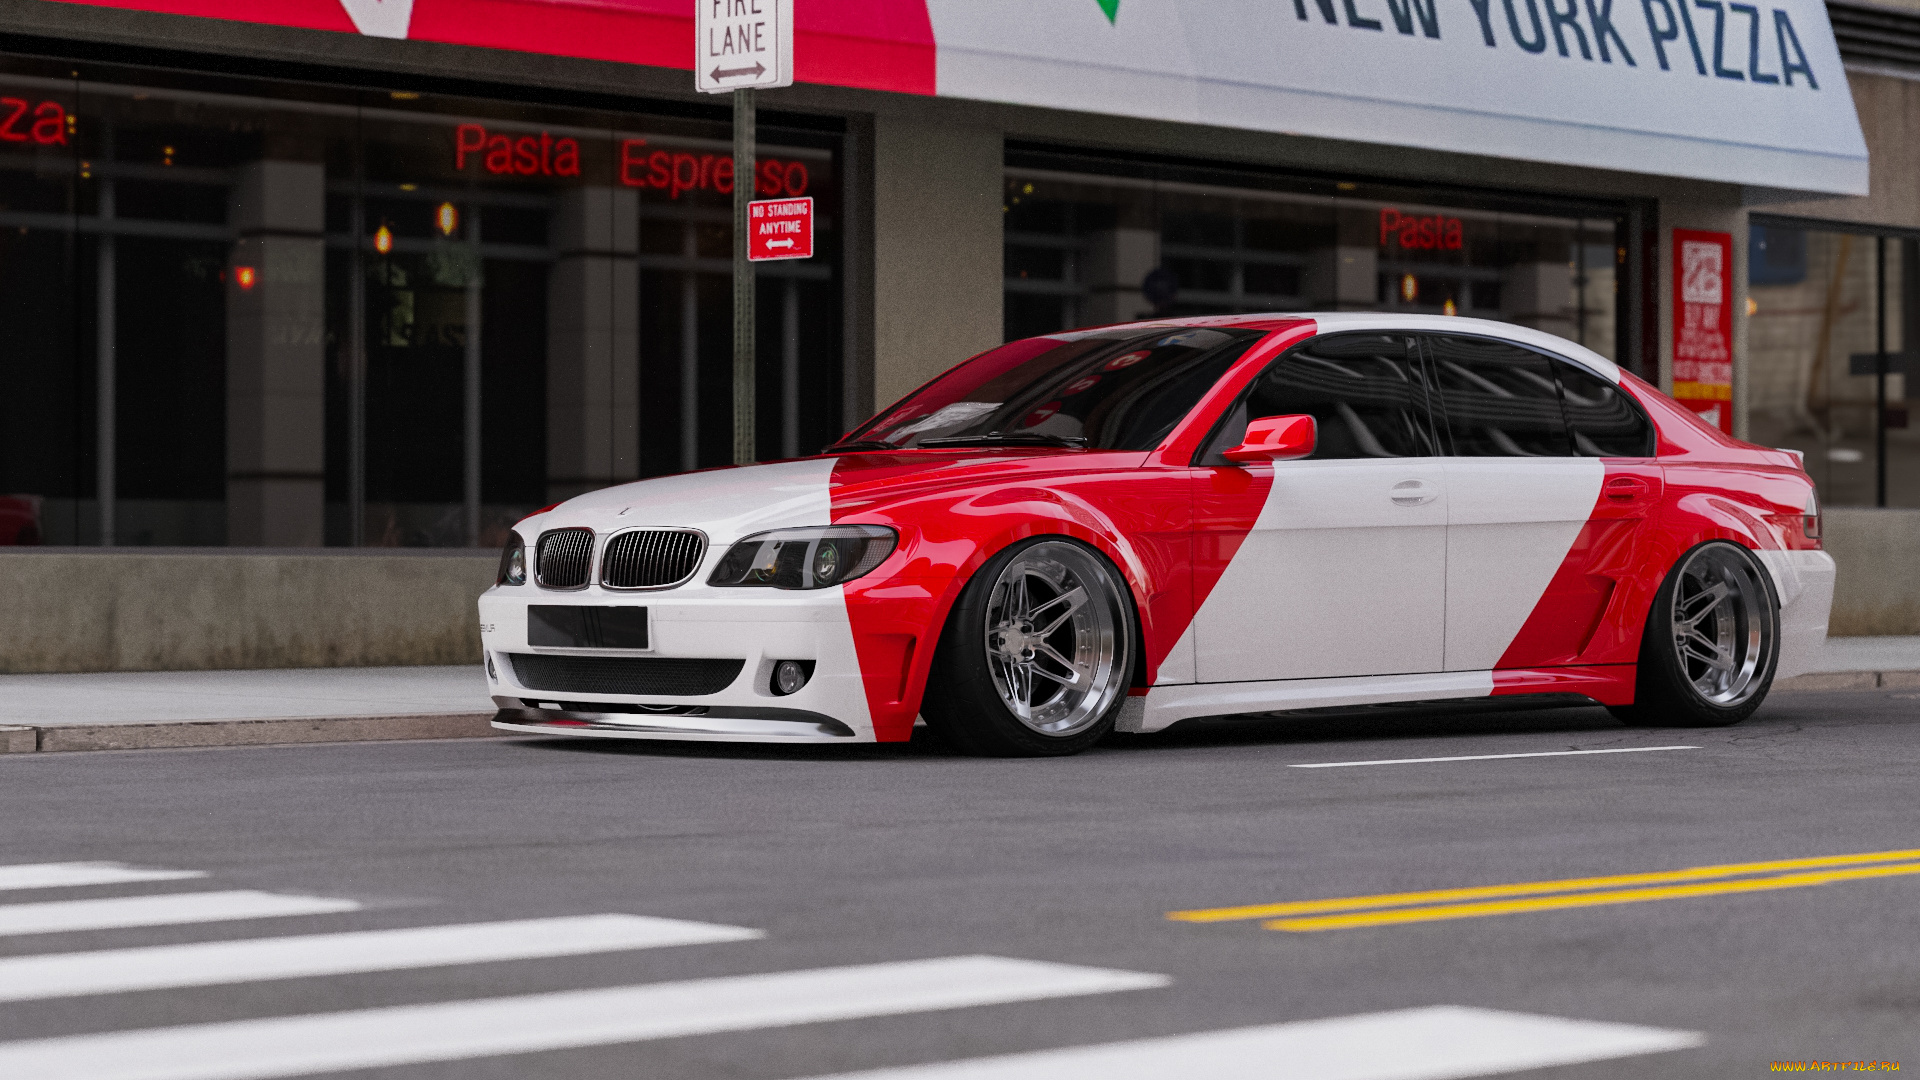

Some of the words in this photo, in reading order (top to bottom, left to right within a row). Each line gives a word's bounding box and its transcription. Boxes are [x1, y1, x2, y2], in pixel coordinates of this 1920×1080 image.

[709, 22, 766, 57] LANE
[1468, 0, 1638, 67] YORK
[1640, 0, 1820, 91] PIZZA
[455, 123, 580, 177] Pasta
[619, 138, 809, 199] Espreso
[752, 205, 765, 218] NO
[767, 202, 808, 217] STANDING
[758, 219, 802, 235] ANYTIME
[1380, 207, 1463, 250] Pasta
